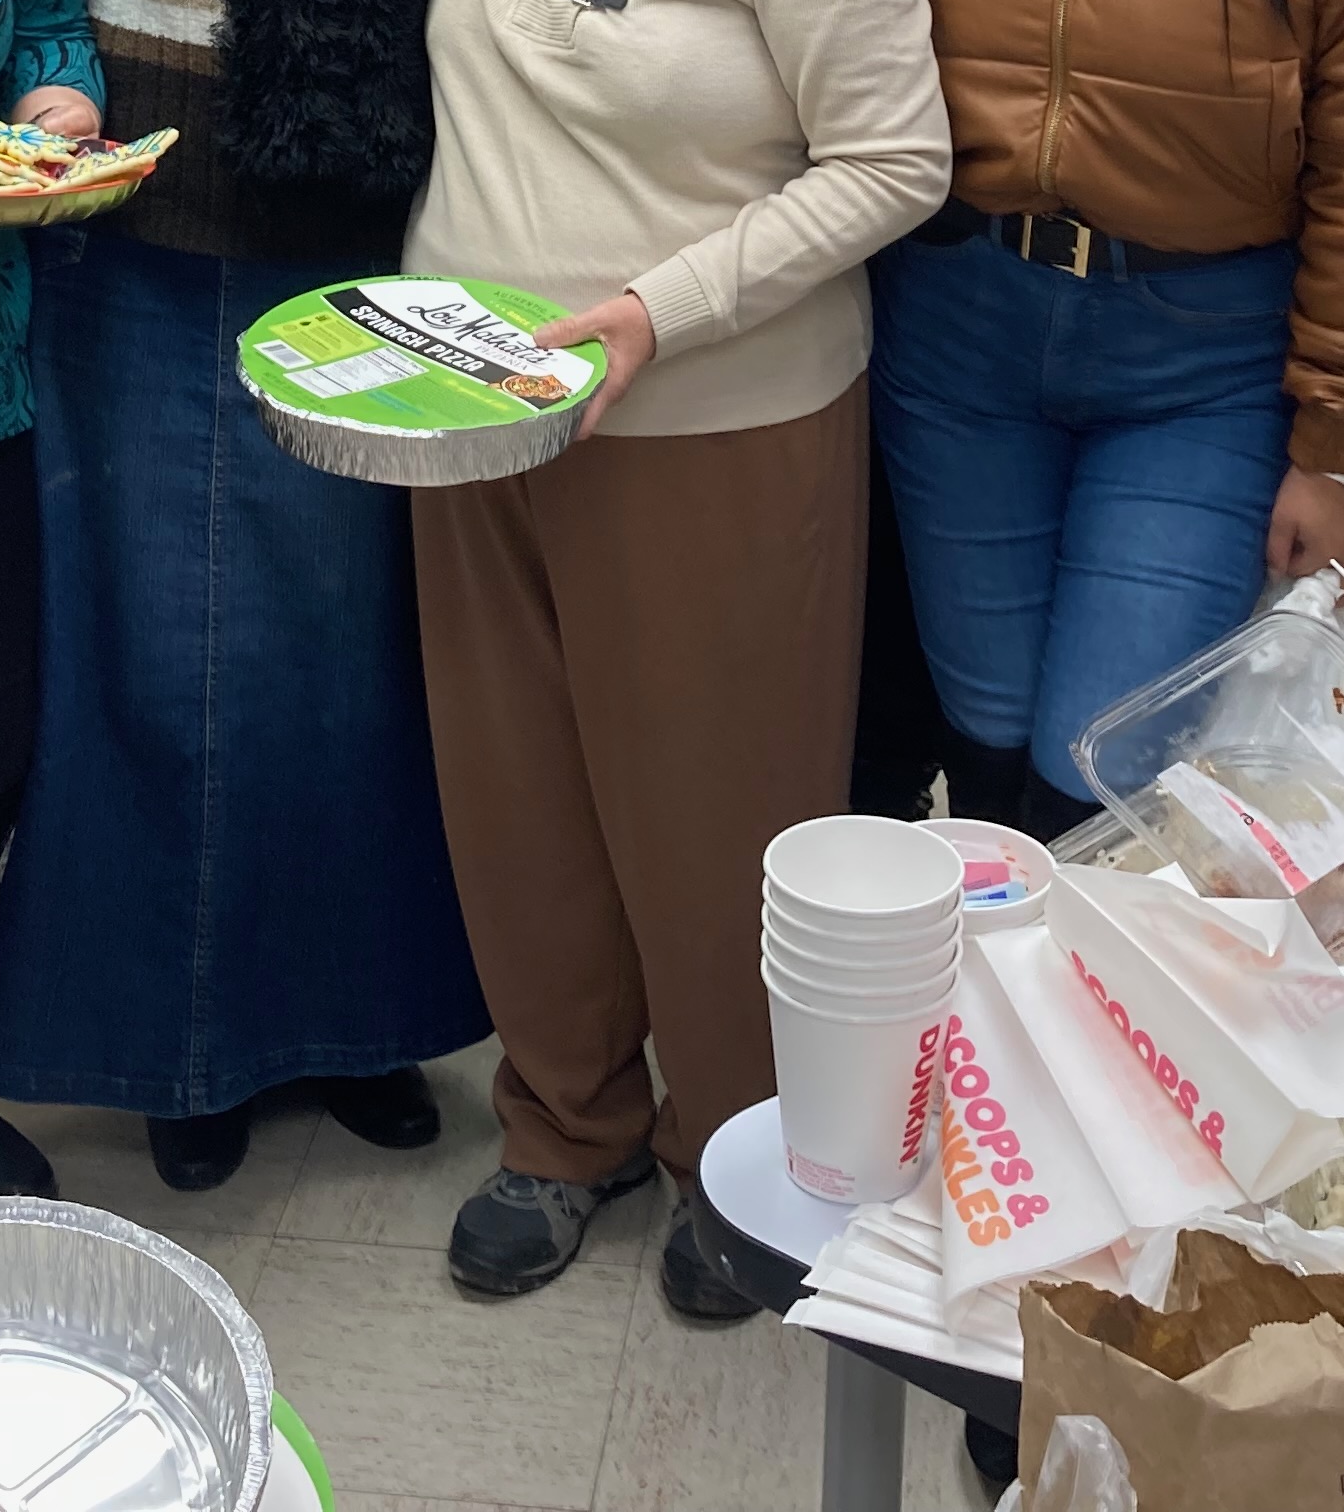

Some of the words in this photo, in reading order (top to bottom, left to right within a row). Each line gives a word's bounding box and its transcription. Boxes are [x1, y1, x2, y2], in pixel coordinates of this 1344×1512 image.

[349, 304, 430, 350] SPINACH
[423, 342, 487, 374] PIZZA
[1006, 1193, 1050, 1229] &
